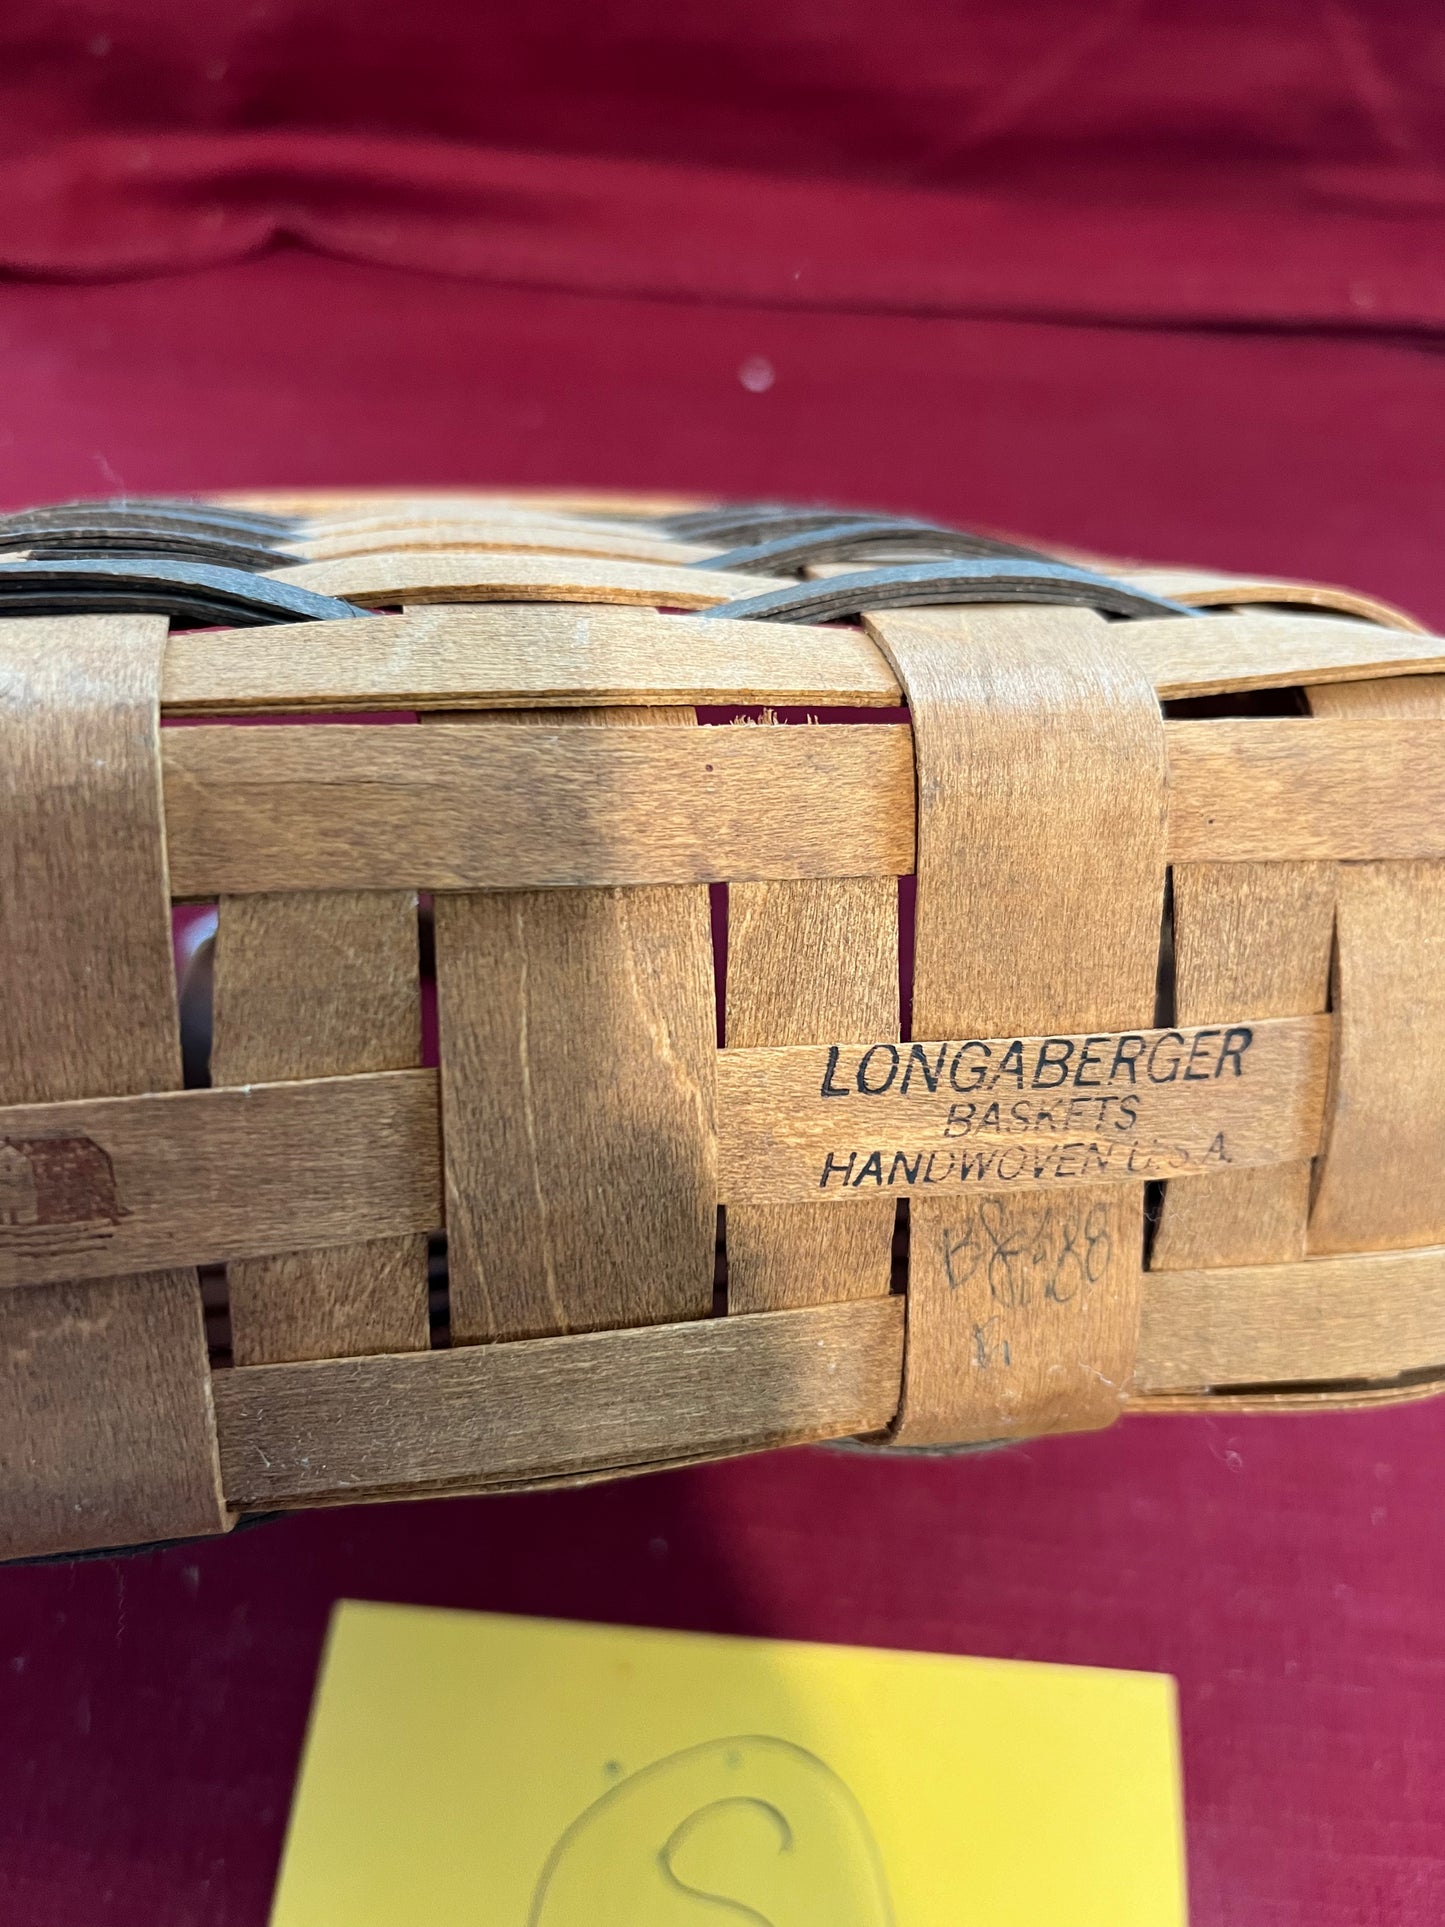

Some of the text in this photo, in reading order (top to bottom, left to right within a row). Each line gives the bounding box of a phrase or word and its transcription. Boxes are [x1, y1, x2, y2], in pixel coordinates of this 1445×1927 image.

[820, 1027, 1254, 1098] LONGABERGER
[943, 1094, 1140, 1139] BASKETS
[819, 1140, 1119, 1188] HANDWOVEN
